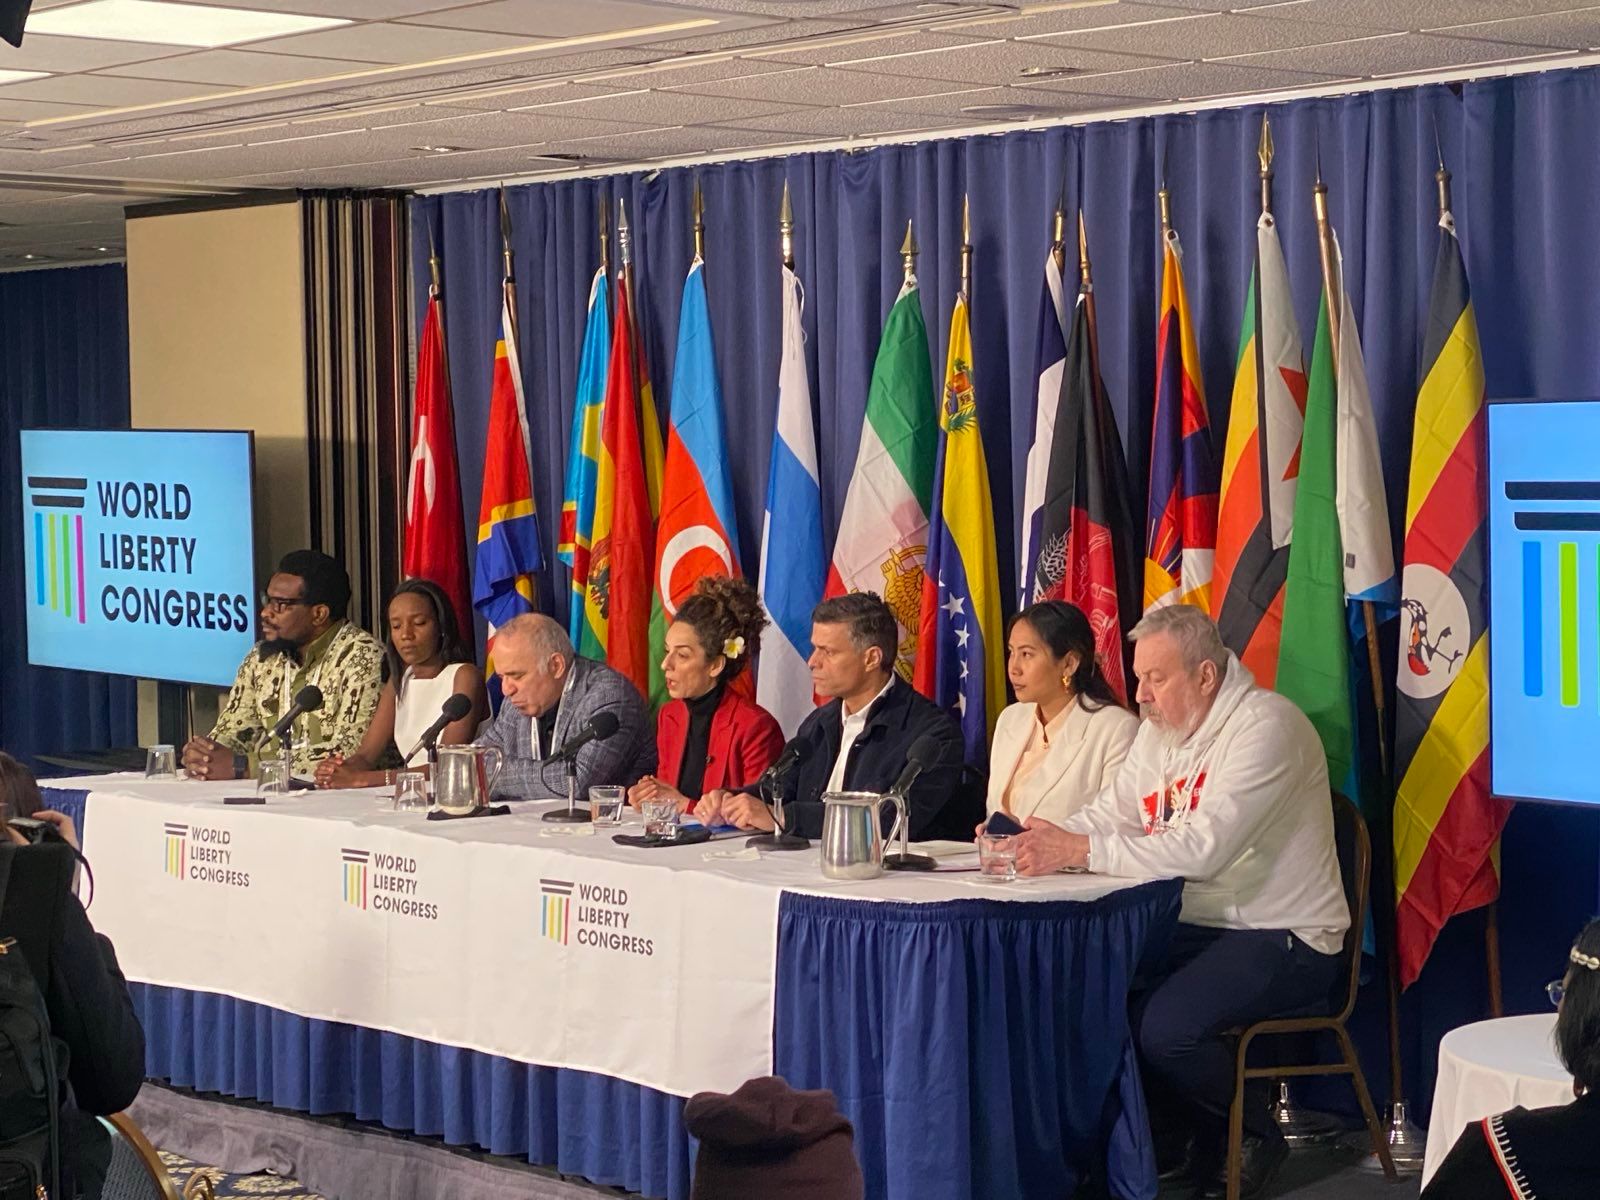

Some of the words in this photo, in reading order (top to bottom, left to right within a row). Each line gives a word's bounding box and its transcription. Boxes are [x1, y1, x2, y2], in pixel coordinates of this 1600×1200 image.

[97, 481, 192, 520] WORLD
[99, 532, 197, 574] LIBERTY
[101, 584, 249, 633] CONGRESS
[191, 826, 231, 845] WORLD
[190, 845, 232, 865] LIBERTY
[374, 852, 417, 874] WORLD
[373, 873, 418, 896] LIBERTY
[579, 882, 628, 906] WORLD
[373, 894, 438, 920] CONGRESS
[578, 905, 630, 929] LIBERTY
[577, 928, 654, 956] CONGRESS
